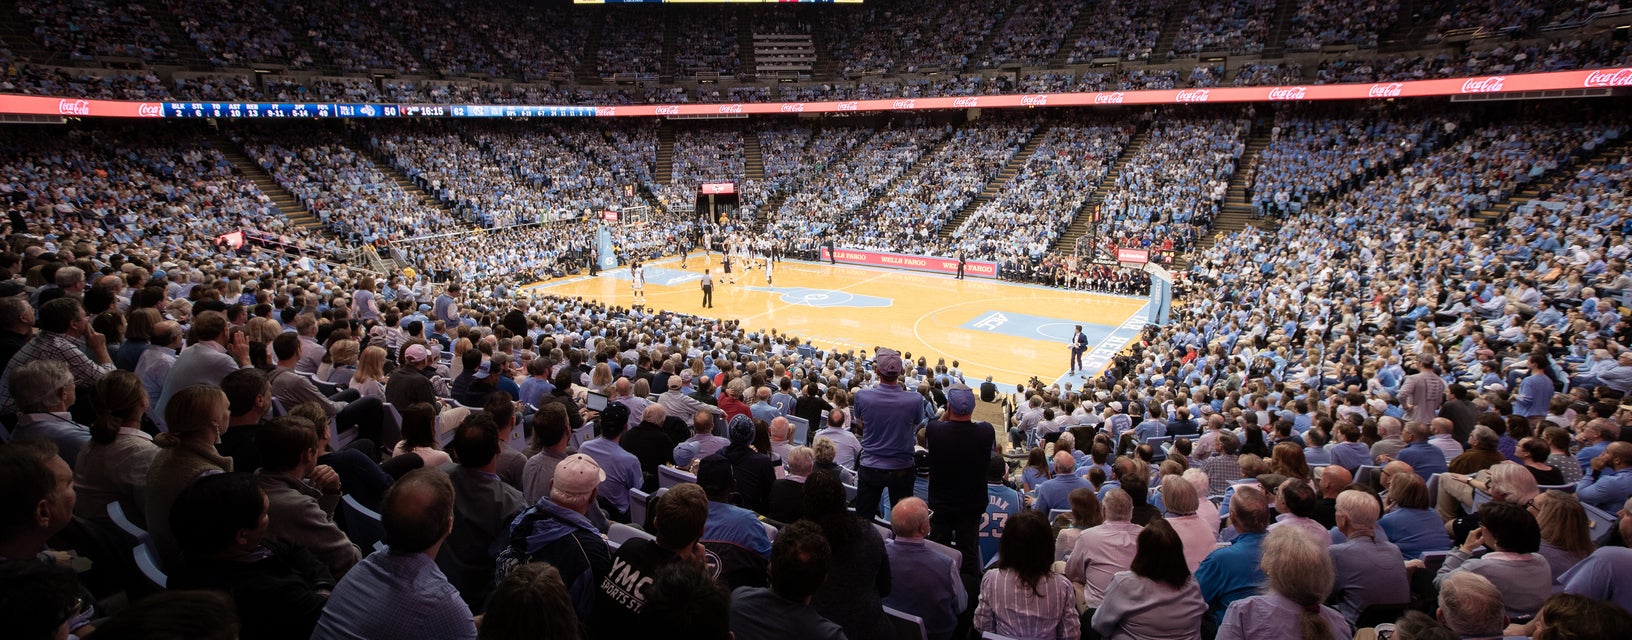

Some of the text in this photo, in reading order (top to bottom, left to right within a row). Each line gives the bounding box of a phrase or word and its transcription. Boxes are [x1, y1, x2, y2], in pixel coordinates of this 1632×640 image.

[195, 110, 202, 118] 6
[213, 110, 221, 118] 8
[230, 110, 241, 118] 10
[247, 110, 259, 118] 13
[266, 110, 285, 118] 9-11
[383, 107, 396, 116] 50
[421, 107, 444, 116] 16:15
[453, 108, 464, 116] 62
[846, 253, 867, 261] FARGO
[881, 256, 926, 267] WELLS FARGO
[943, 262, 993, 273] WELS FARGO
[979, 513, 1008, 538] 23
[600, 579, 630, 606] SPORTS
